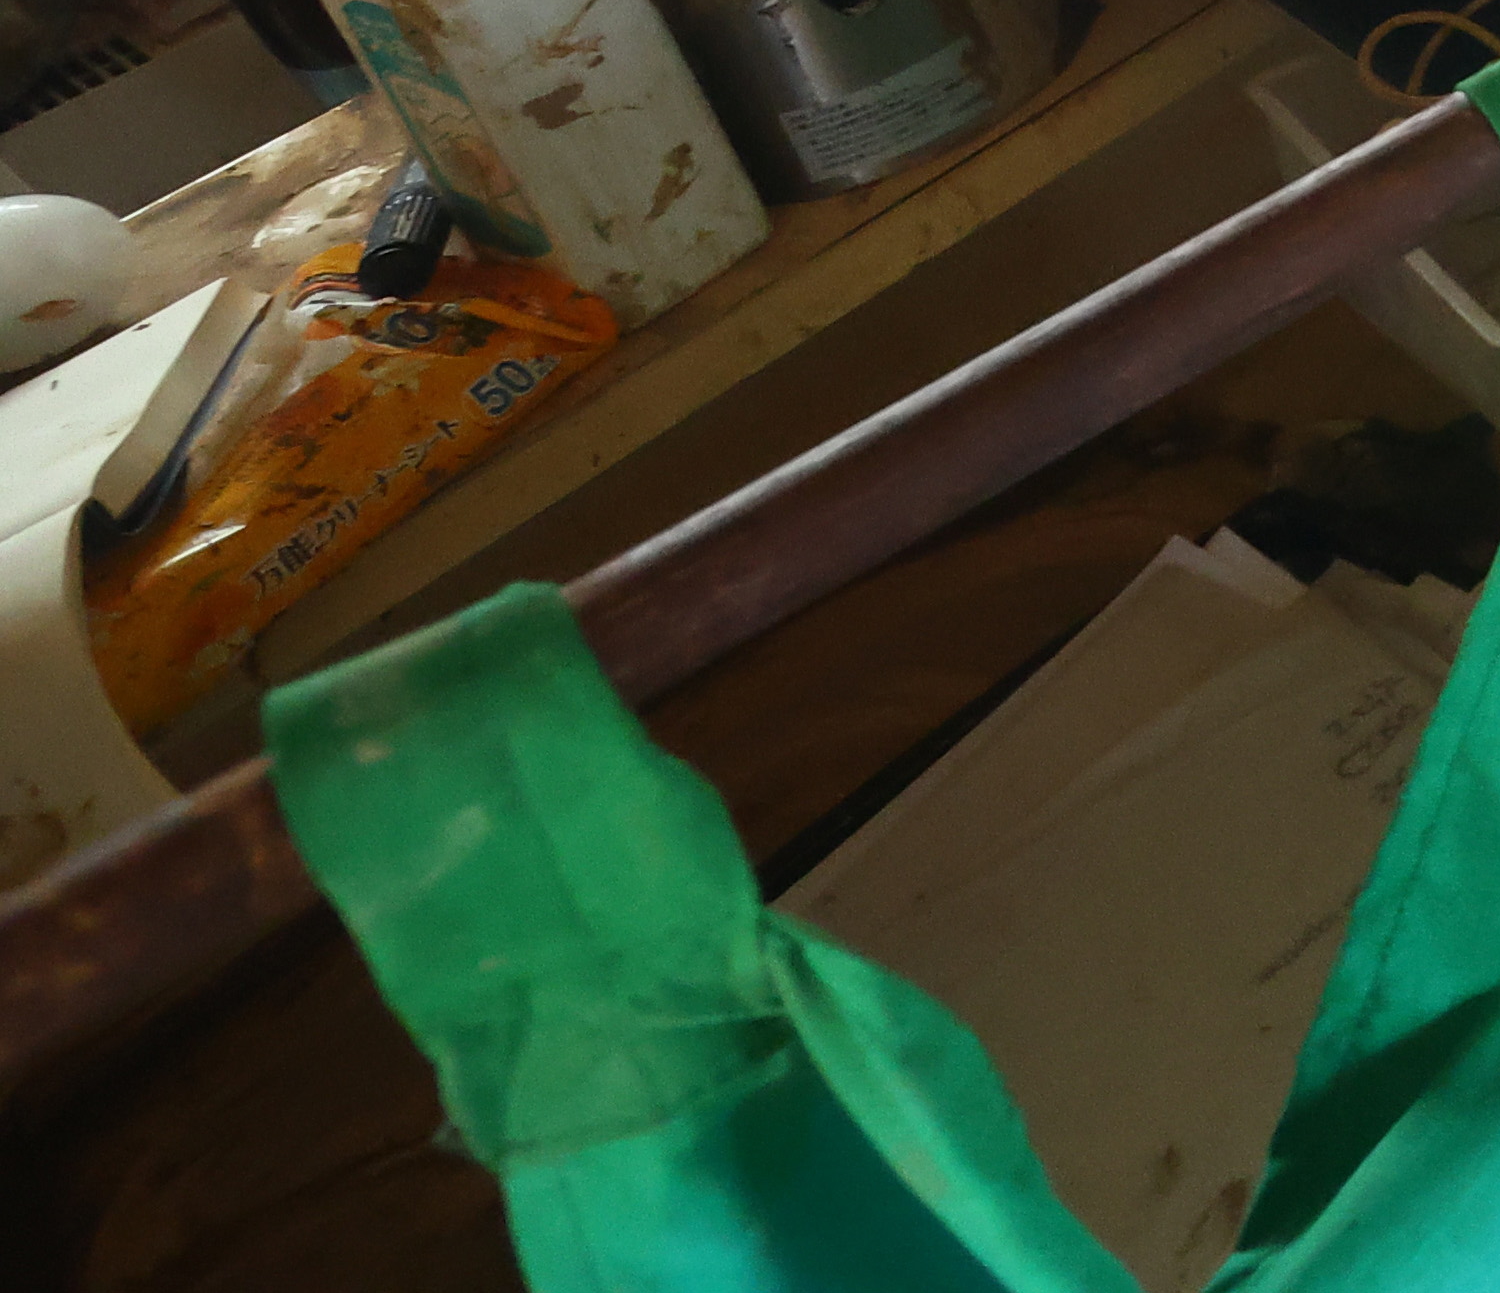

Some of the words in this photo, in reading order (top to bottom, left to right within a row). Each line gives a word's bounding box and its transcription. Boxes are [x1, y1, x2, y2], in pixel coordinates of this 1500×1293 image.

[242, 416, 461, 598] 万能クリーナーシート
